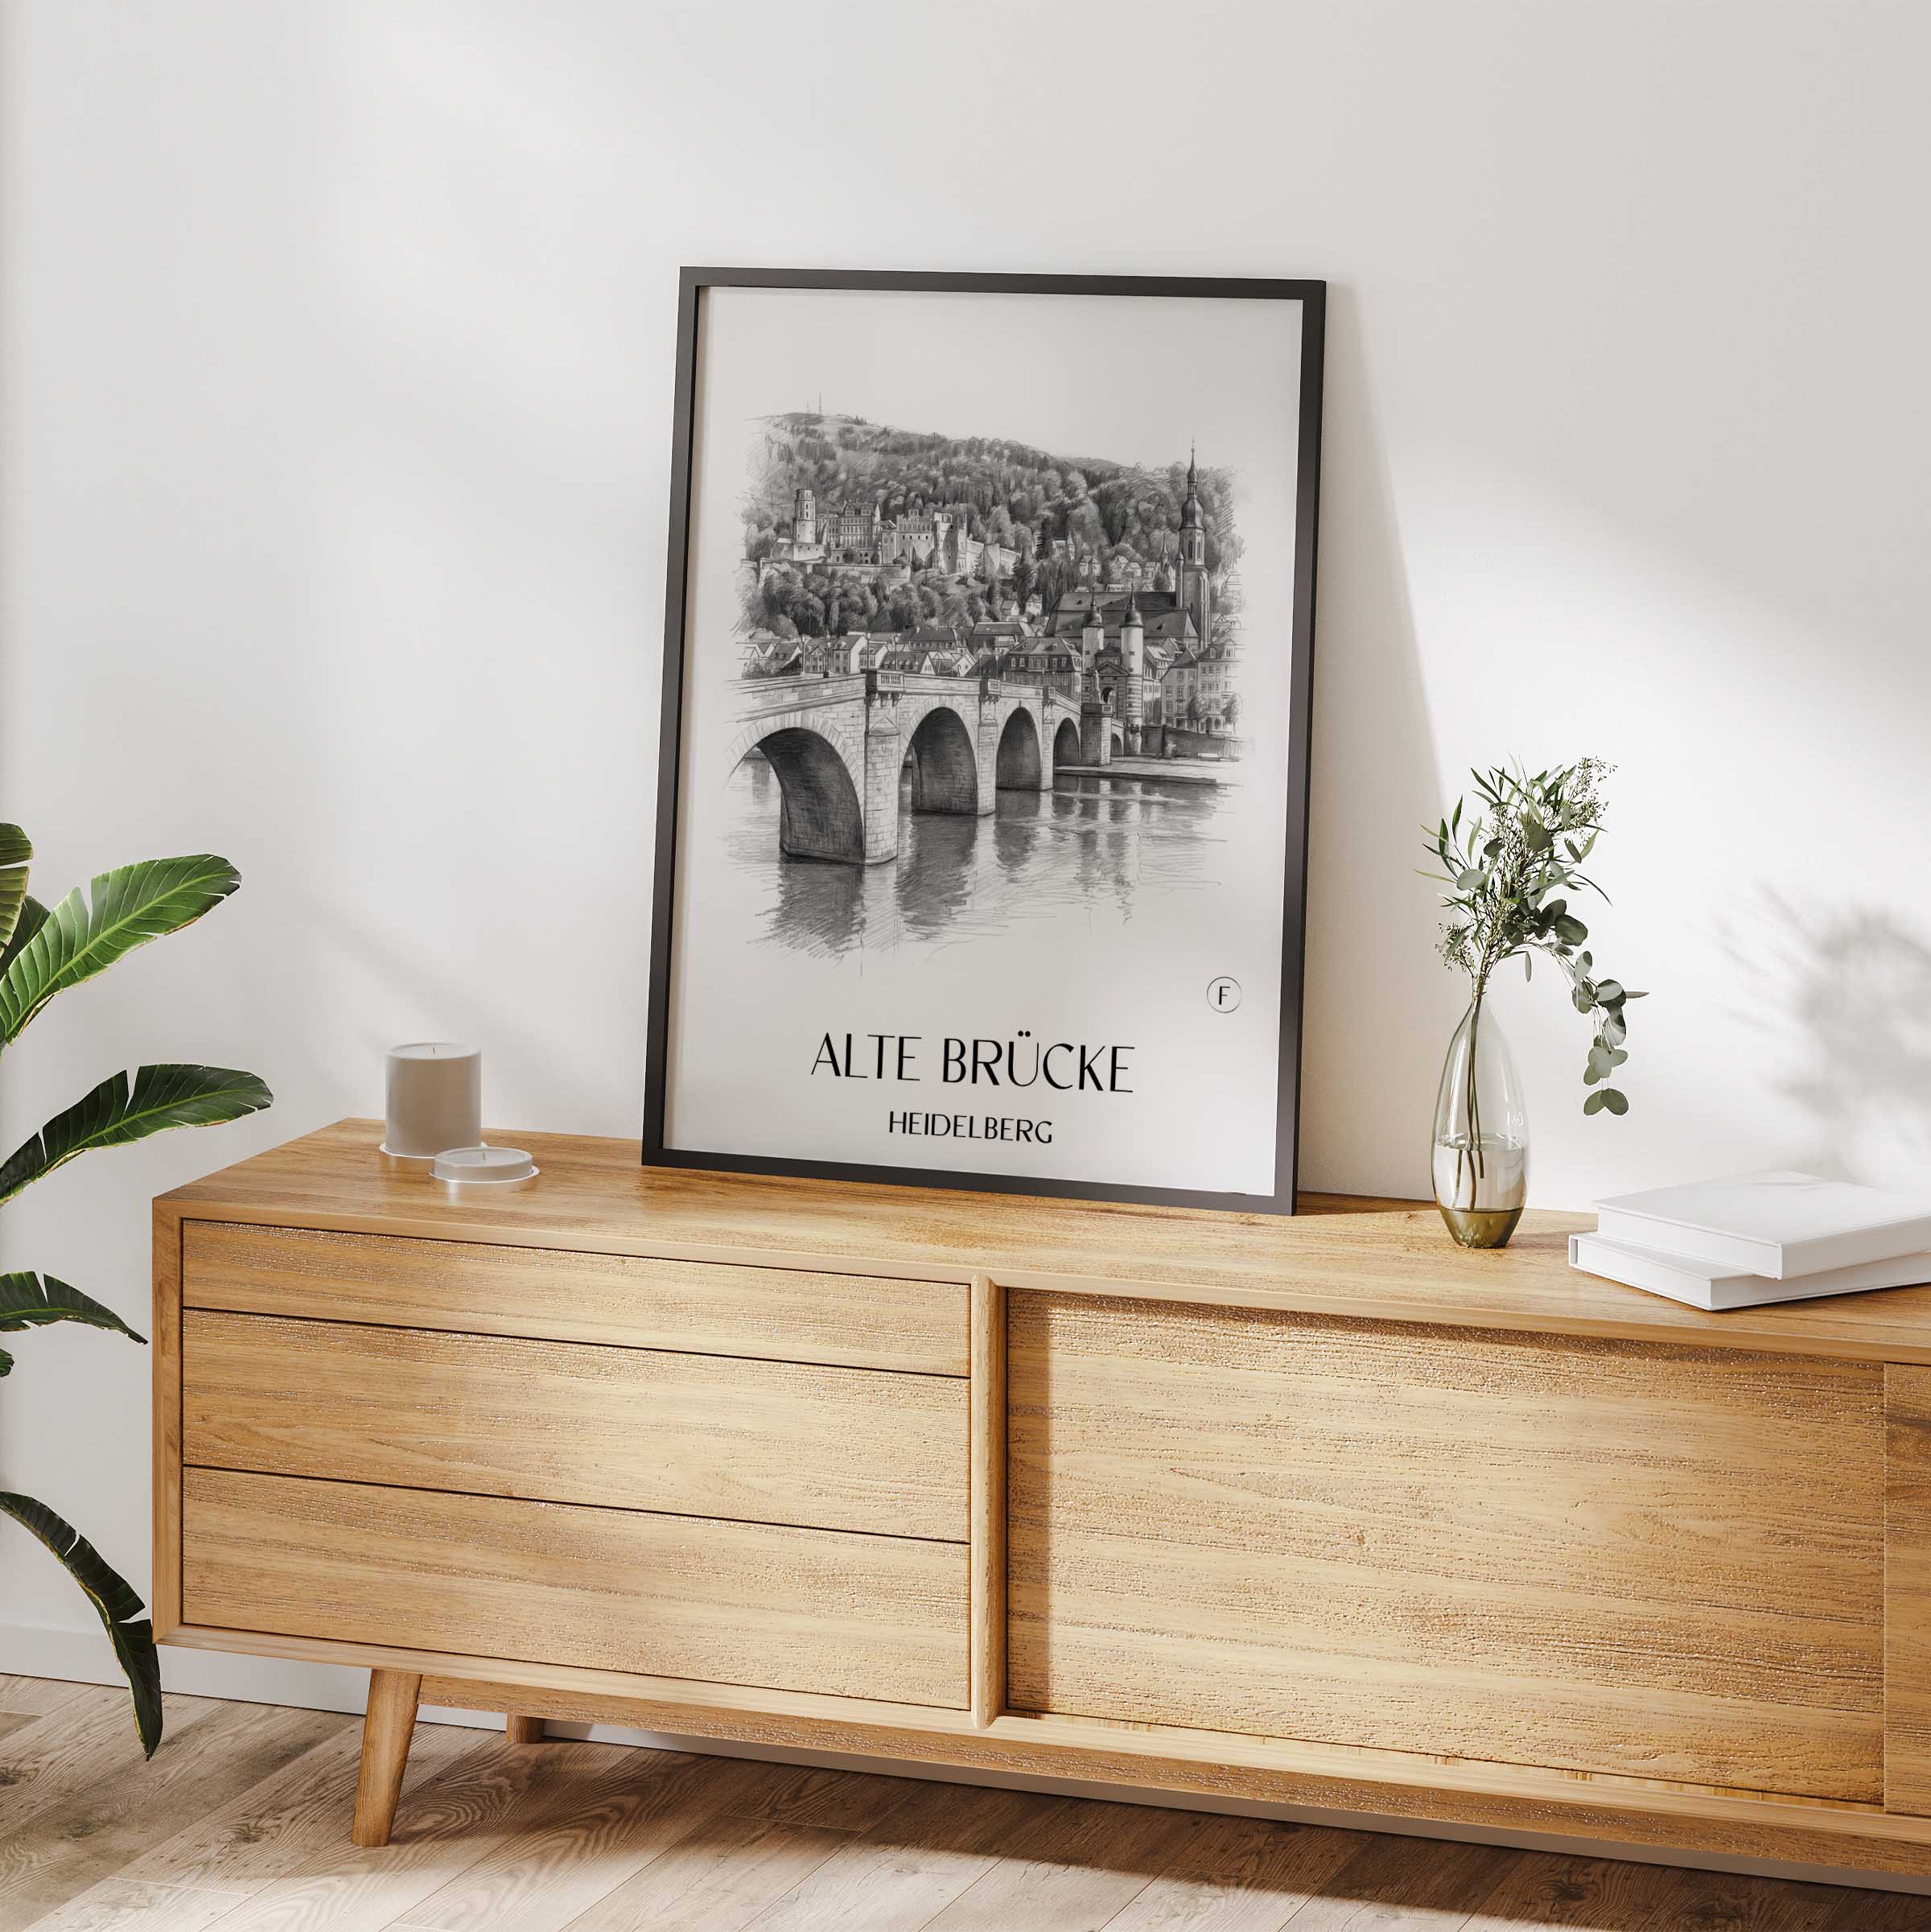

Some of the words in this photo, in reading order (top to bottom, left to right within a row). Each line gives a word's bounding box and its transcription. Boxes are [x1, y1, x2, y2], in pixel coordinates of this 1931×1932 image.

[1218, 986, 1230, 1005] F
[810, 1032, 923, 1081] ALTE
[942, 1030, 1135, 1094] BRÜCKE
[888, 1110, 1053, 1144] HEIDELBERG
